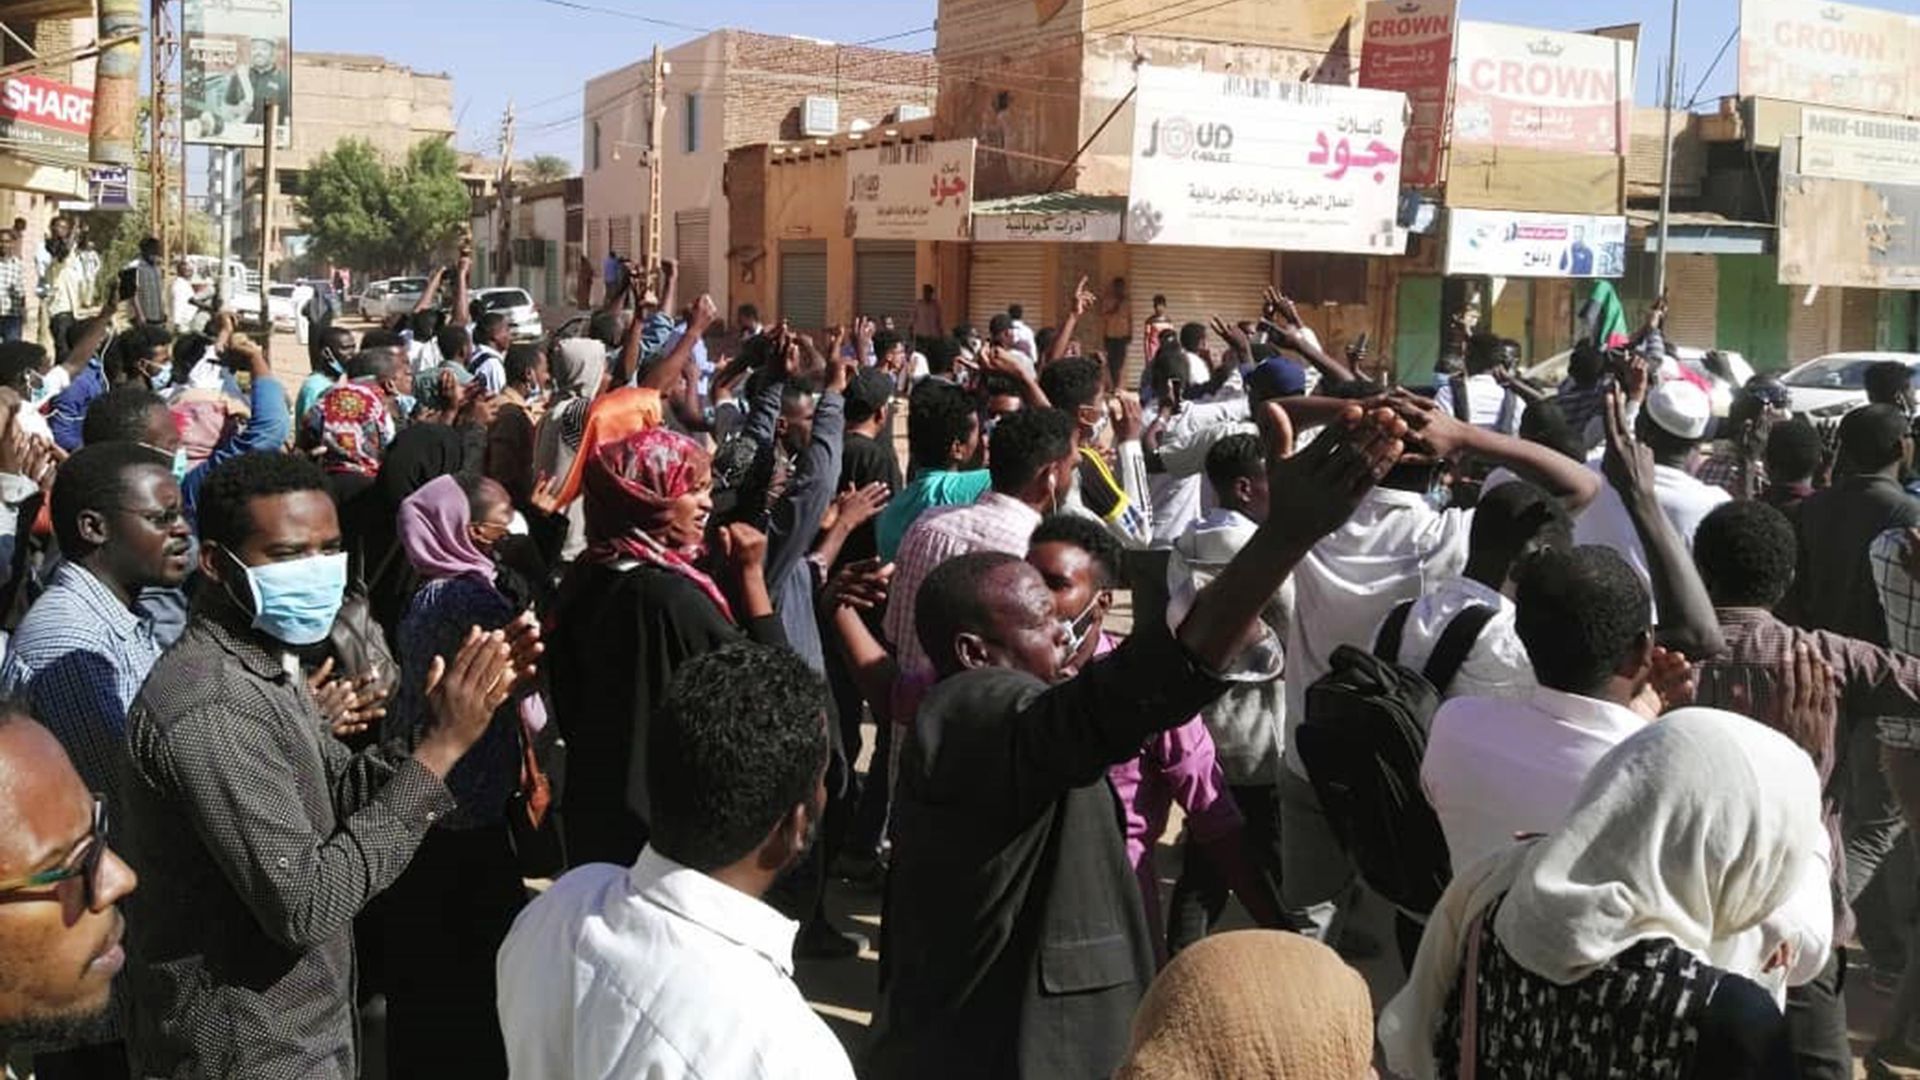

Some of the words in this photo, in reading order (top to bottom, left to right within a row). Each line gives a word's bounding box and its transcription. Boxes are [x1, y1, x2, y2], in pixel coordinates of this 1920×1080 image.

[1368, 15, 1448, 38] CROWN
[1773, 19, 1887, 60] CROWN
[1470, 58, 1615, 100] CROWN
[1307, 130, 1399, 185] جود
